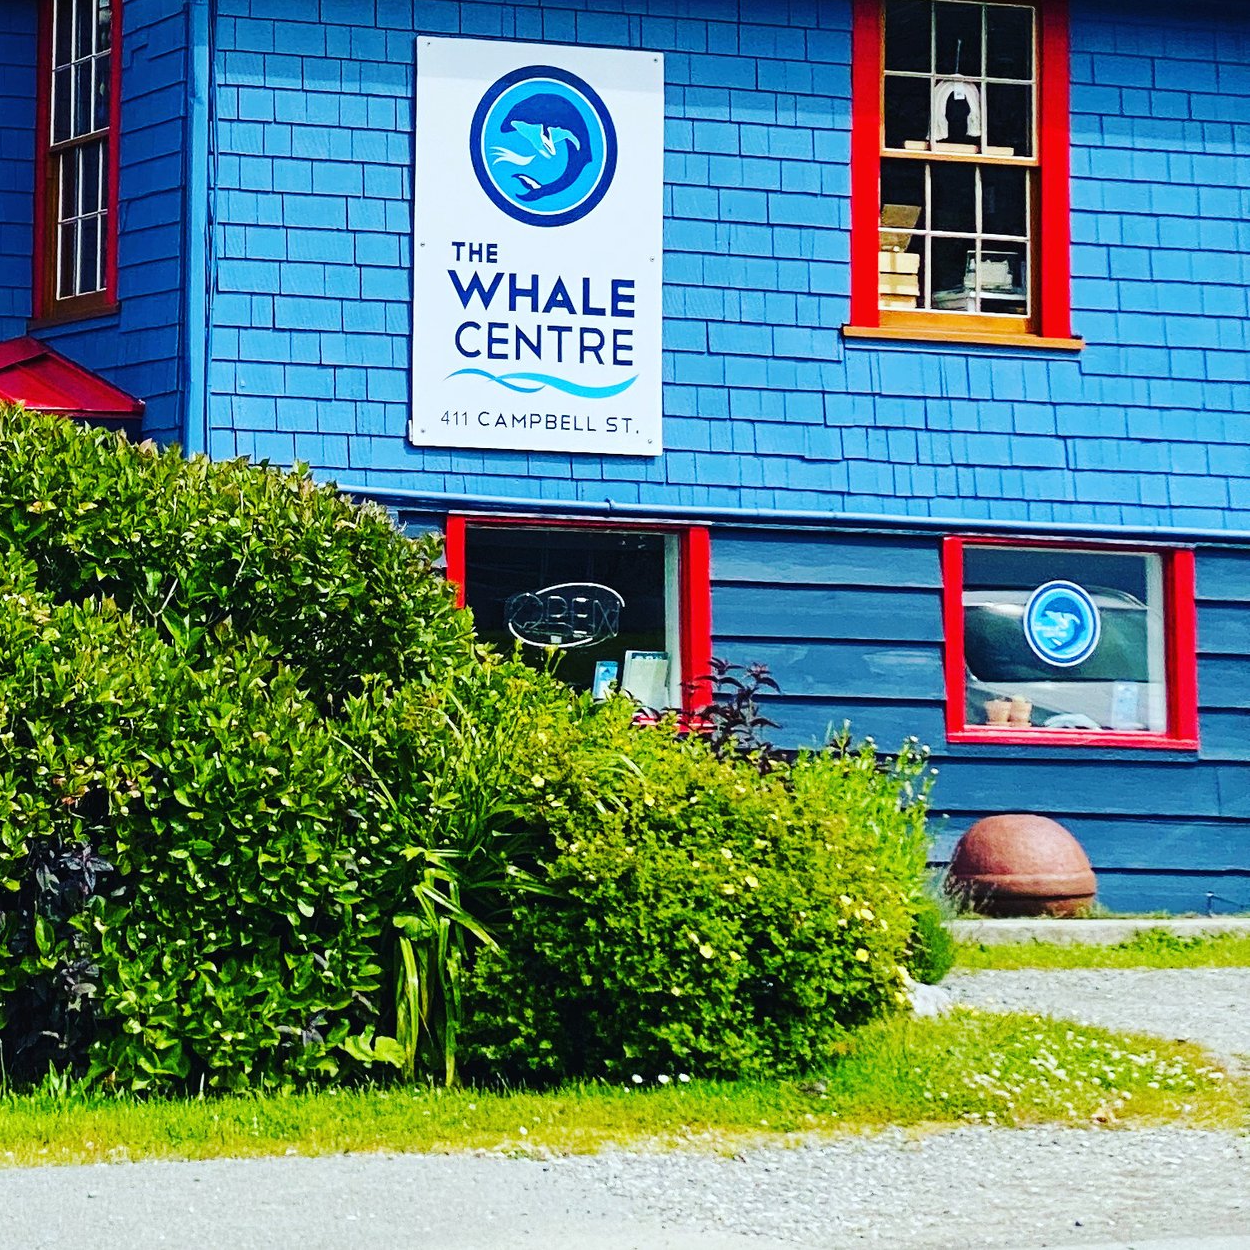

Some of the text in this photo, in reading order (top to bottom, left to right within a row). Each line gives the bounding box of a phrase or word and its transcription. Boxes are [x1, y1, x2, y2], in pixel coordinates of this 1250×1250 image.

[451, 241, 498, 264] THE
[447, 269, 635, 319] WHALE
[454, 320, 634, 367] CENTRE
[440, 410, 639, 435] 411 CAMPBELL ST.
[509, 591, 621, 638] OPEN
